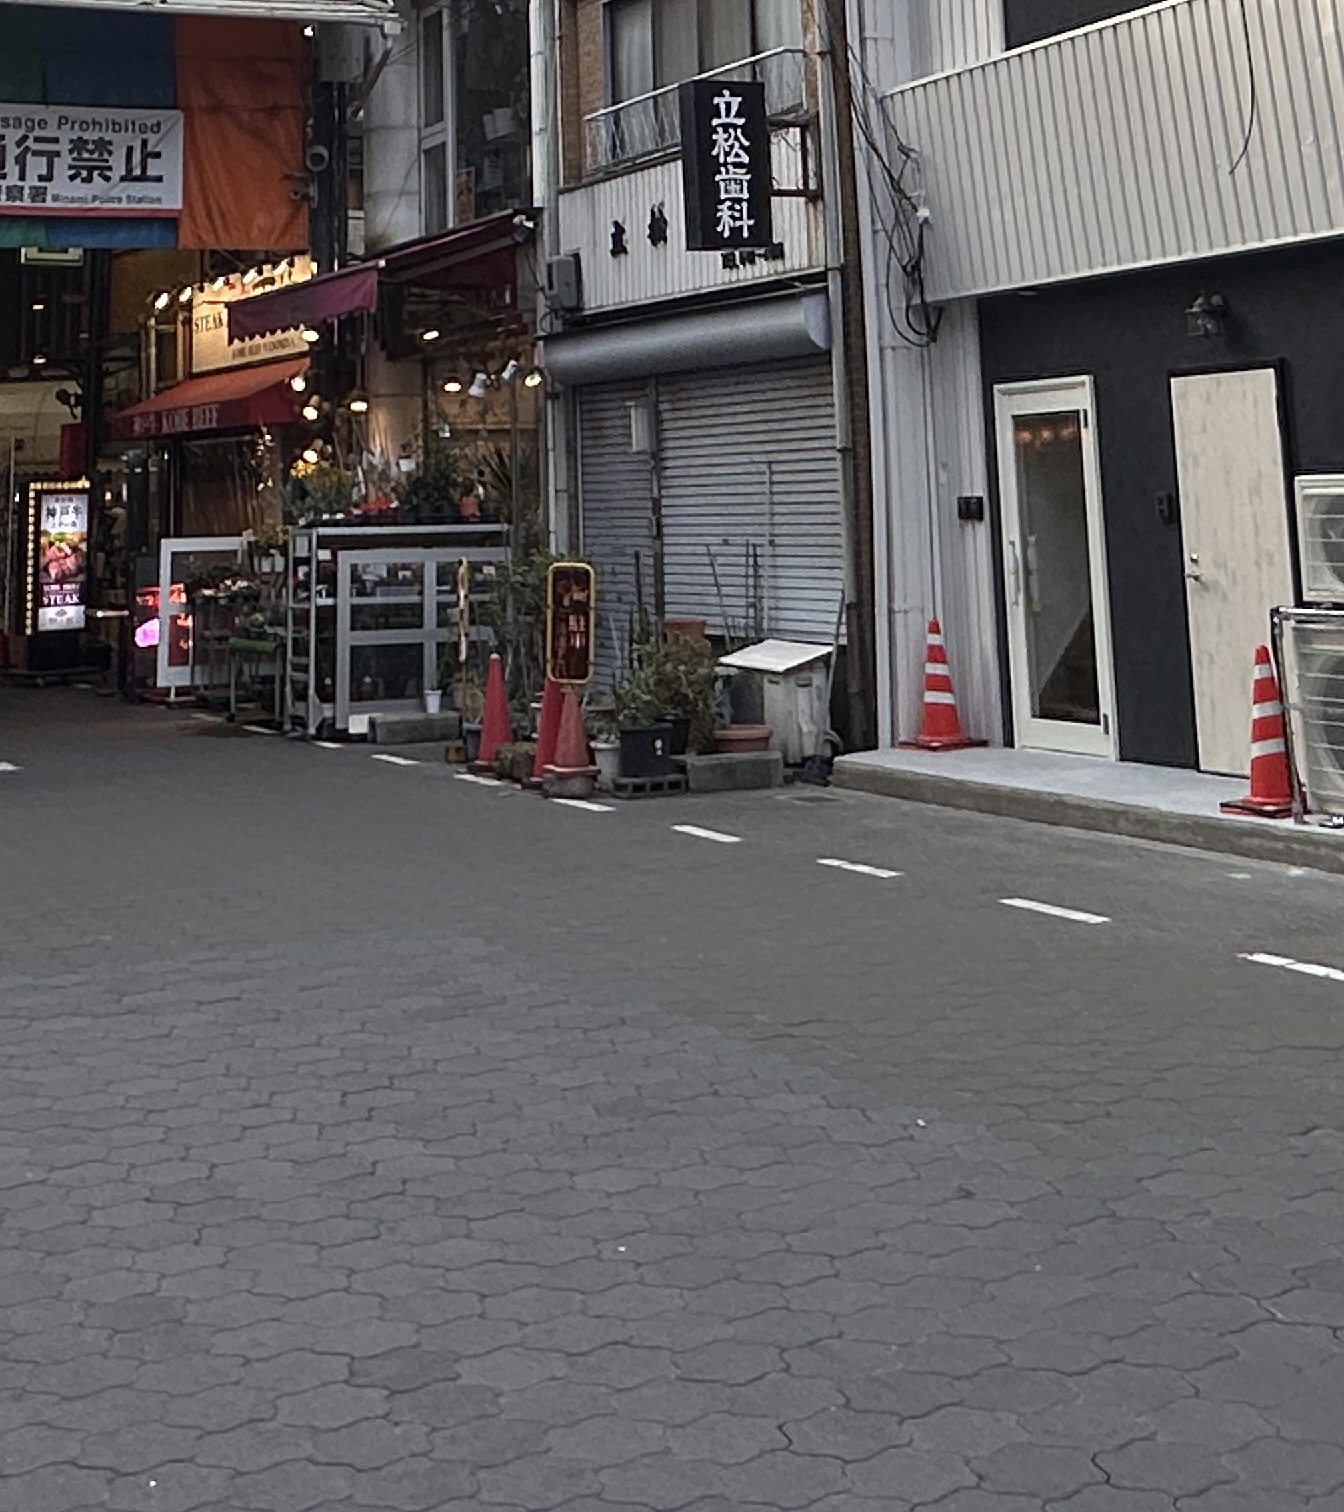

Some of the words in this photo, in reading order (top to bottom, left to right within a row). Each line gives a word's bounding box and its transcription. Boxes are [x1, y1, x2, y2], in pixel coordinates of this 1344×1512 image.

[57, 113, 163, 135] Prohibited
[711, 89, 755, 238] 立松歯科
[193, 311, 224, 335] STEAK
[192, 404, 220, 431] BEEF
